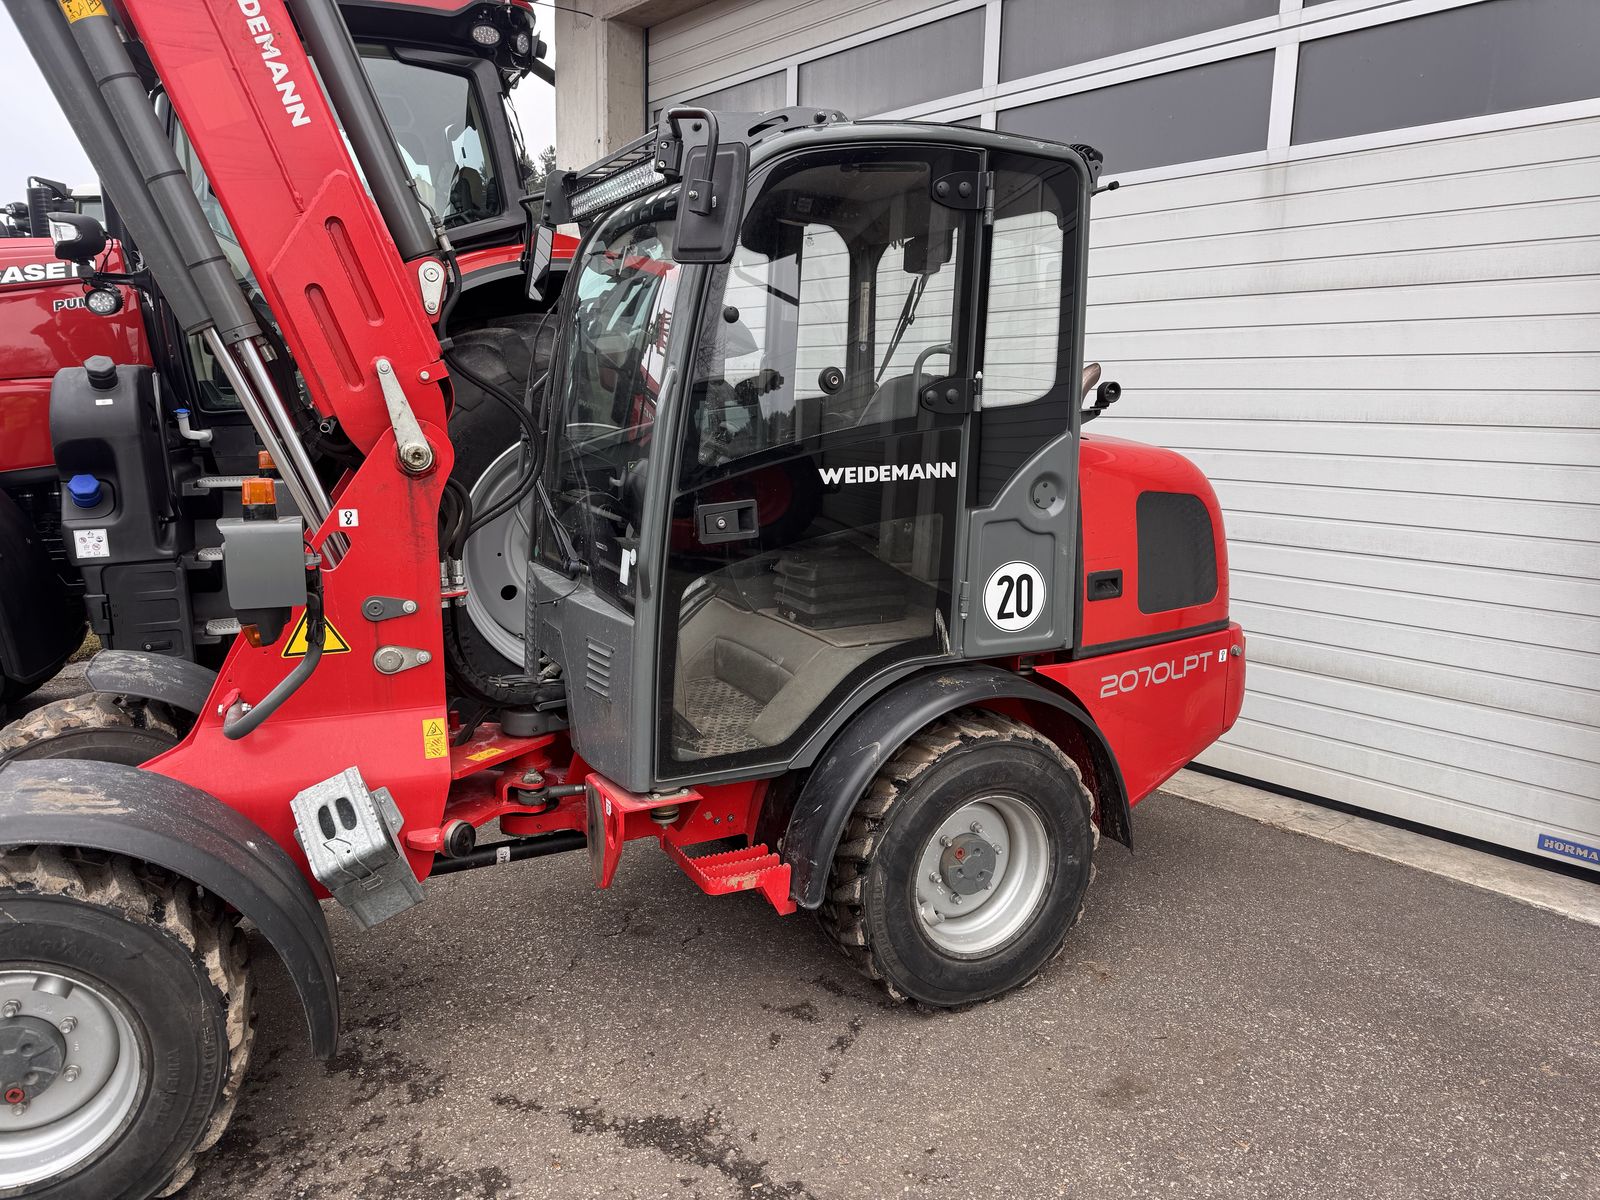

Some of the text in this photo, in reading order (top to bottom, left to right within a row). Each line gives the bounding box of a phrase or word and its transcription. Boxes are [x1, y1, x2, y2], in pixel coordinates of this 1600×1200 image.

[0, 262, 66, 283] ASE
[818, 461, 957, 485] WEIDEMANN
[997, 573, 1033, 620] 20
[1100, 651, 1213, 698] 2070LPT
[1543, 838, 1599, 861] HÖRMA
